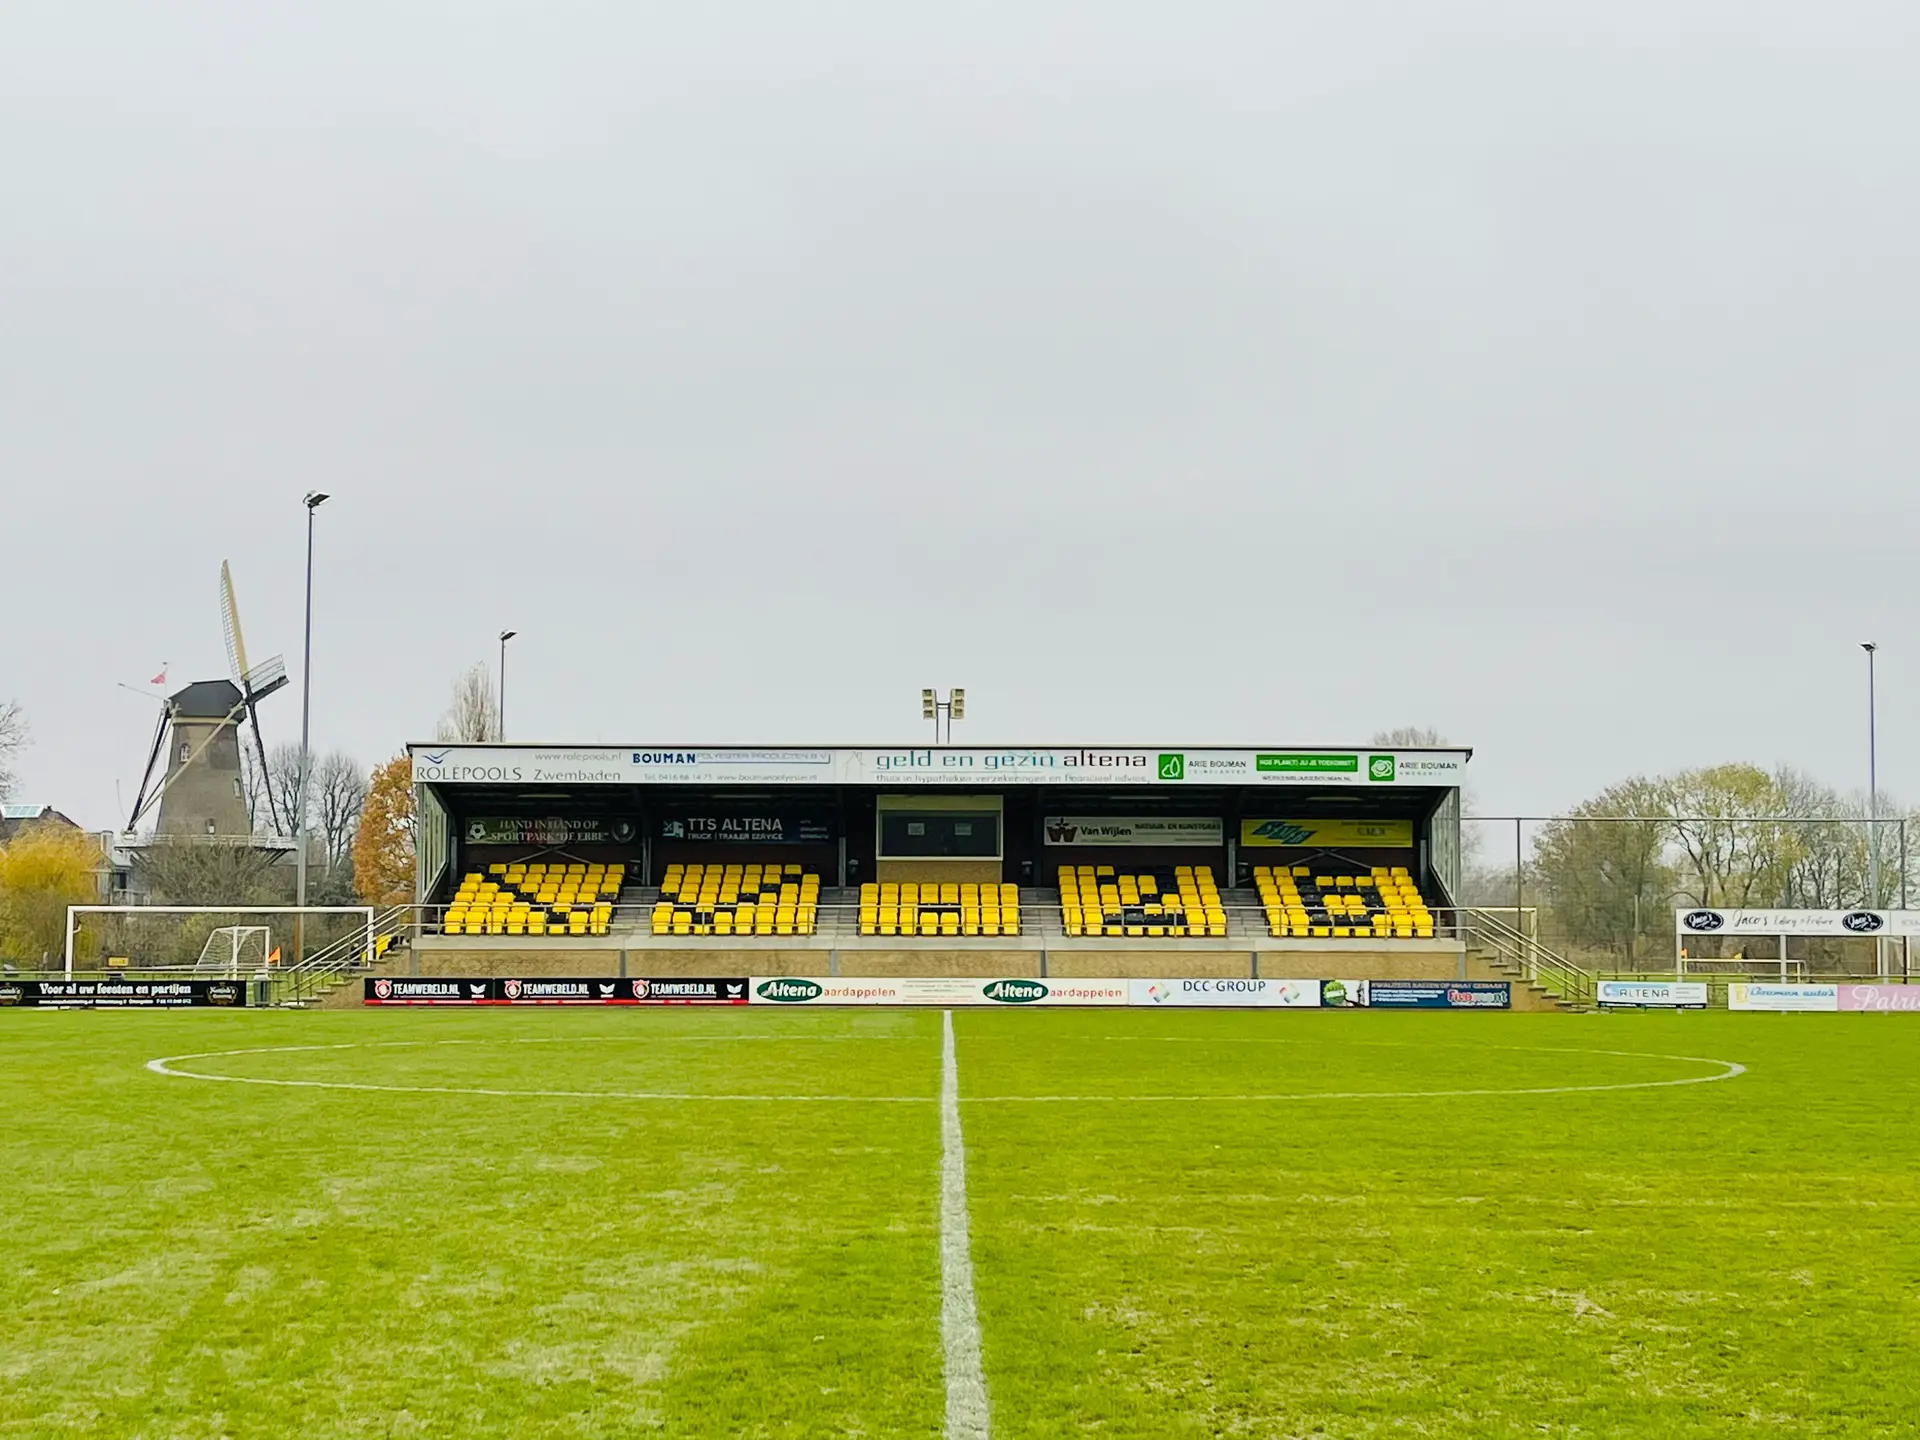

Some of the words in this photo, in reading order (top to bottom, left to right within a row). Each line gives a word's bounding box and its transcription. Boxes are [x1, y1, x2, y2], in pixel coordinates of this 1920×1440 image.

[633, 753, 696, 764] BOUMAN
[877, 750, 931, 769] geld
[943, 755, 973, 767] en
[984, 751, 1054, 769] gezin
[1063, 750, 1147, 767] altena
[1188, 760, 1208, 768] ARIE
[1210, 760, 1247, 768] BOUMAN
[416, 764, 523, 781] ROLÉPOOLS
[533, 769, 621, 781] Zwembaden
[583, 820, 599, 829] OP
[688, 818, 717, 831] TTS
[722, 818, 783, 831] ALTENA
[1080, 827, 1099, 836] Van
[1101, 827, 1132, 837] Wijlen
[39, 983, 64, 994] Voor
[65, 983, 77, 994] al
[79, 986, 95, 994] uw
[97, 983, 134, 994] feesten
[136, 986, 149, 994] en
[151, 984, 192, 996] partijen
[393, 983, 460, 995] TEAMWERELD.NL
[523, 983, 589, 995] TEAMWERELD.NL
[651, 983, 717, 995] TEAMWERELD.NL
[761, 982, 817, 997] Altena
[824, 988, 896, 998] aardappelen
[987, 983, 1043, 998] Altena
[1050, 988, 1122, 998] aardappelen
[1619, 988, 1670, 998] ALTENA
[1852, 985, 1920, 1010] Patri
